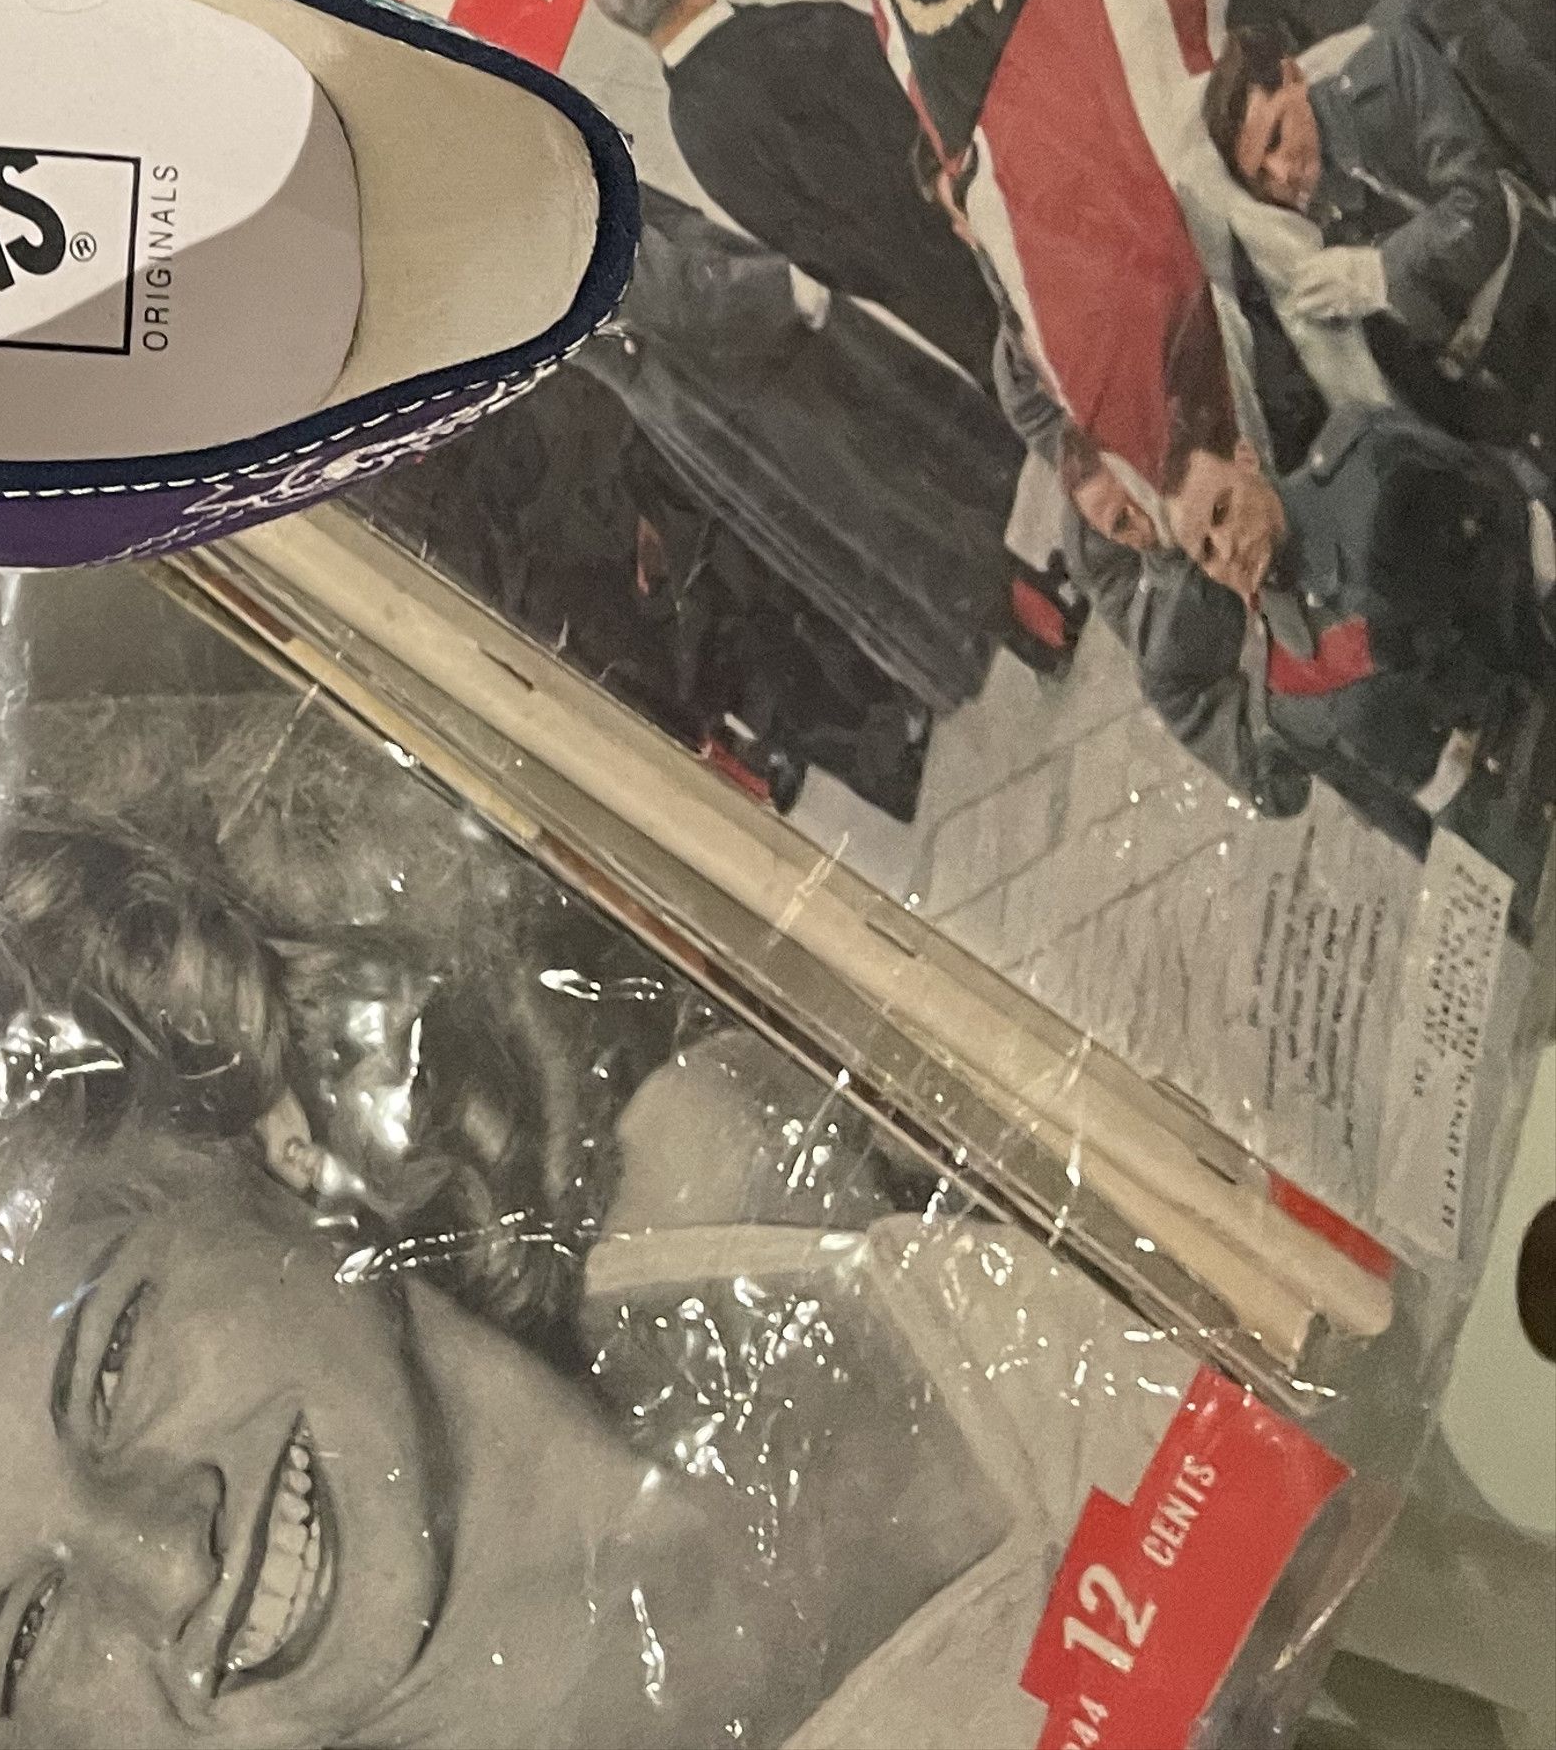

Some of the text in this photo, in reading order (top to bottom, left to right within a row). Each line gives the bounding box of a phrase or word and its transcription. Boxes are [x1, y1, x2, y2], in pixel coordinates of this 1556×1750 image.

[142, 164, 179, 351] ORIGINALS
[1063, 1455, 1215, 1674] 12 CENTS
